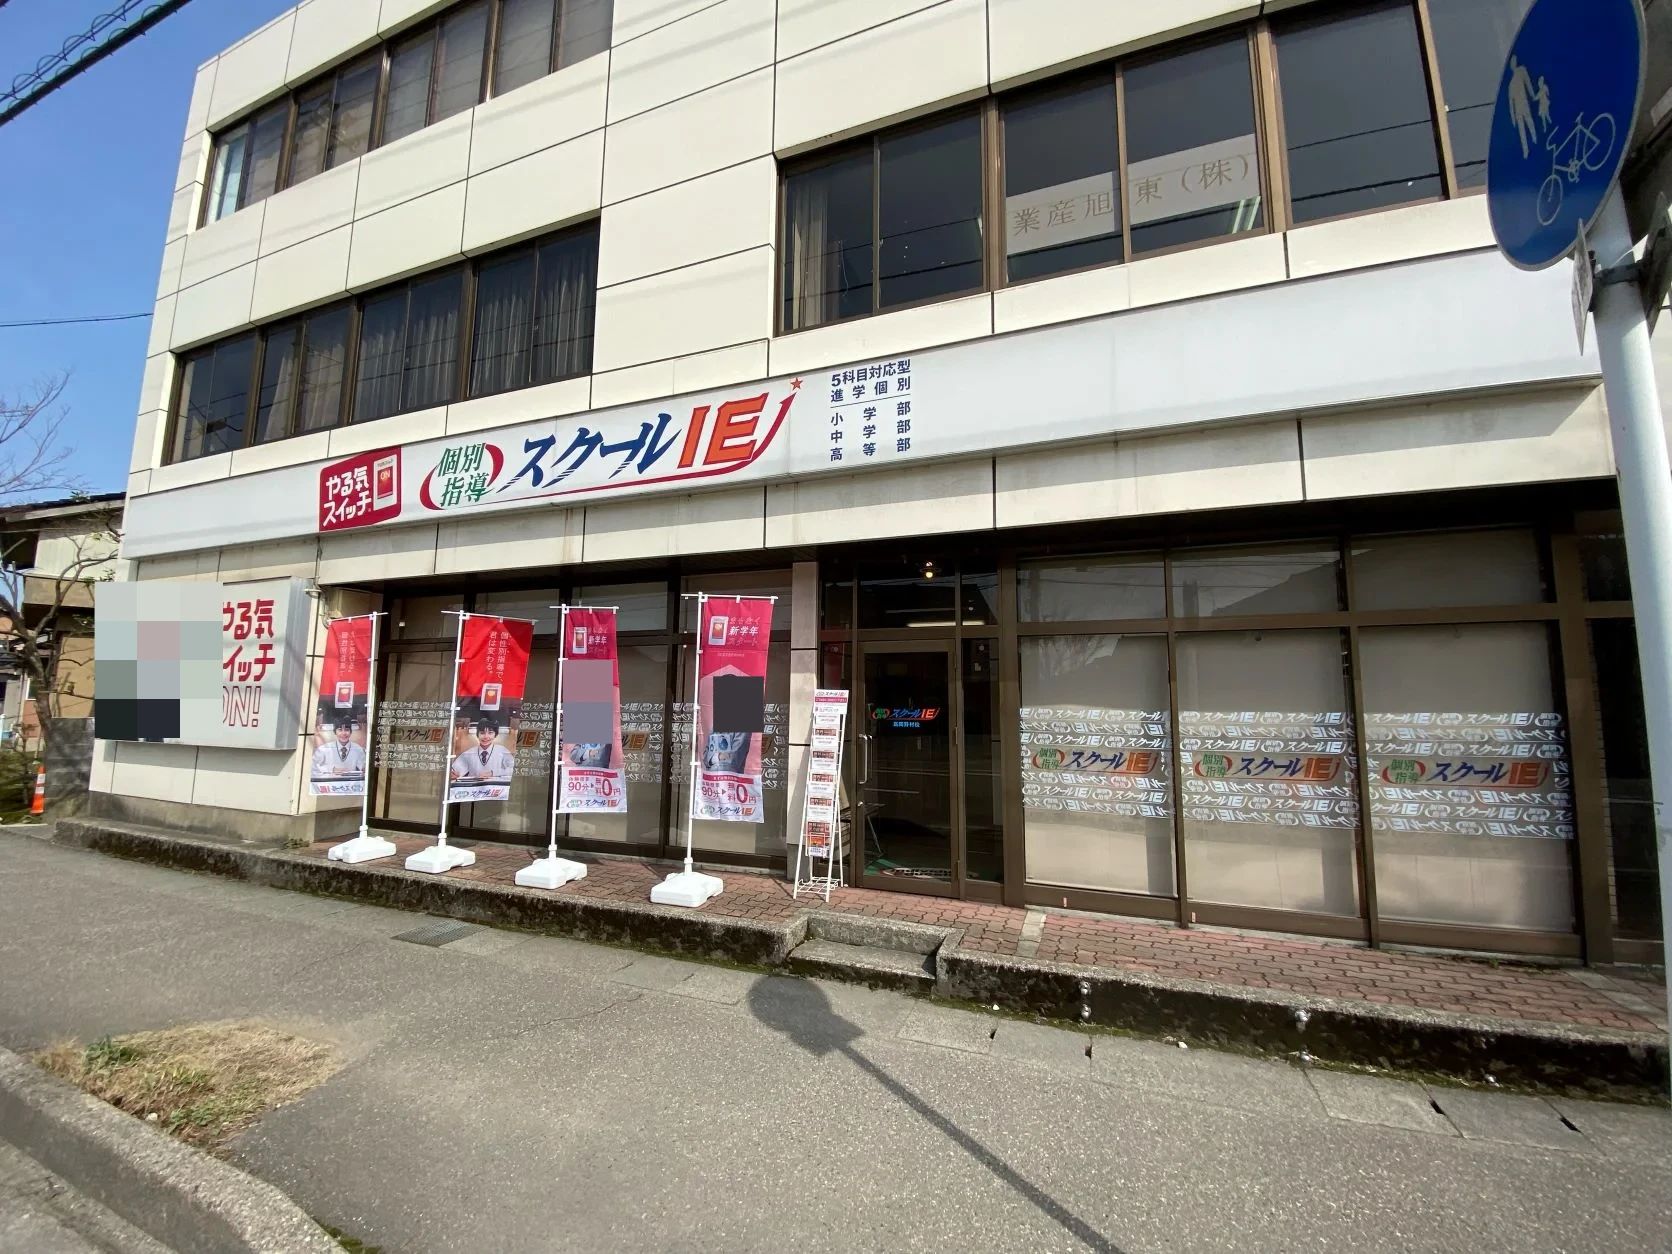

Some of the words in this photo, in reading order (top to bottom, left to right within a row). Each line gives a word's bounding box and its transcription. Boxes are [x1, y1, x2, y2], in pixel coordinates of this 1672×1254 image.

[831, 359, 911, 387] 5科目対応型
[831, 376, 911, 403] 進学個別
[830, 401, 911, 427] 小学部
[497, 392, 770, 491] スクールIE
[830, 419, 911, 444] 中学部
[438, 443, 486, 477] 個別
[830, 437, 911, 461] 高等部
[326, 465, 369, 500] やる気
[380, 469, 391, 480] ON
[440, 473, 490, 507] 指導
[323, 491, 371, 527] スイッチ
[728, 626, 759, 636] 新学年
[223, 645, 275, 681] イッチ
[223, 686, 262, 727] N!
[889, 708, 936, 718] スクールIE
[1064, 751, 1152, 771] スクールIE
[1232, 757, 1334, 779] スクールIE
[1427, 762, 1542, 785] スクールIE
[568, 782, 589, 791] 90分
[701, 787, 720, 798] 90分
[584, 799, 617, 808] スクールIE
[715, 807, 753, 817] スクールIE
